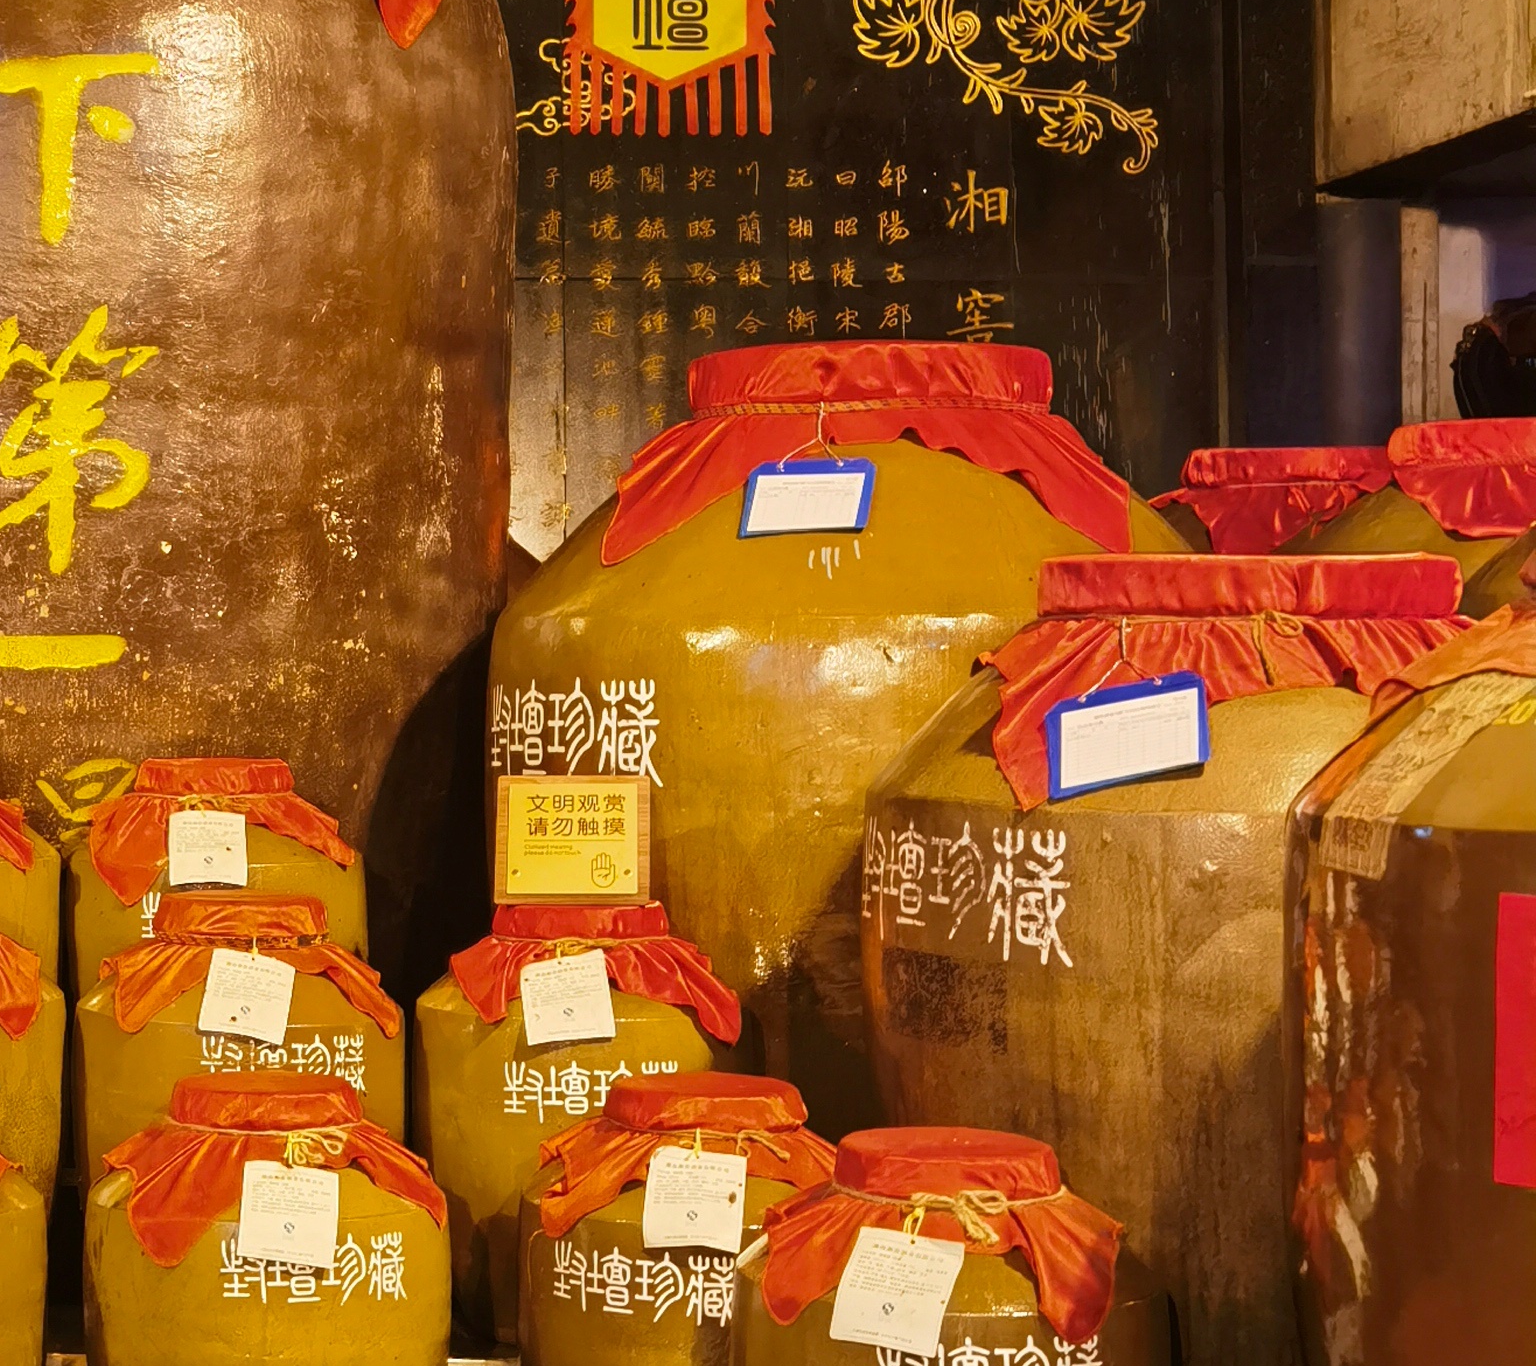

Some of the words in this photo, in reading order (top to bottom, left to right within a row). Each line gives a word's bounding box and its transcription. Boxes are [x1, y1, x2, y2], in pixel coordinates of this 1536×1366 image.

[526, 794, 626, 813] 文明观赏
[526, 816, 626, 837] 请勿触摸
